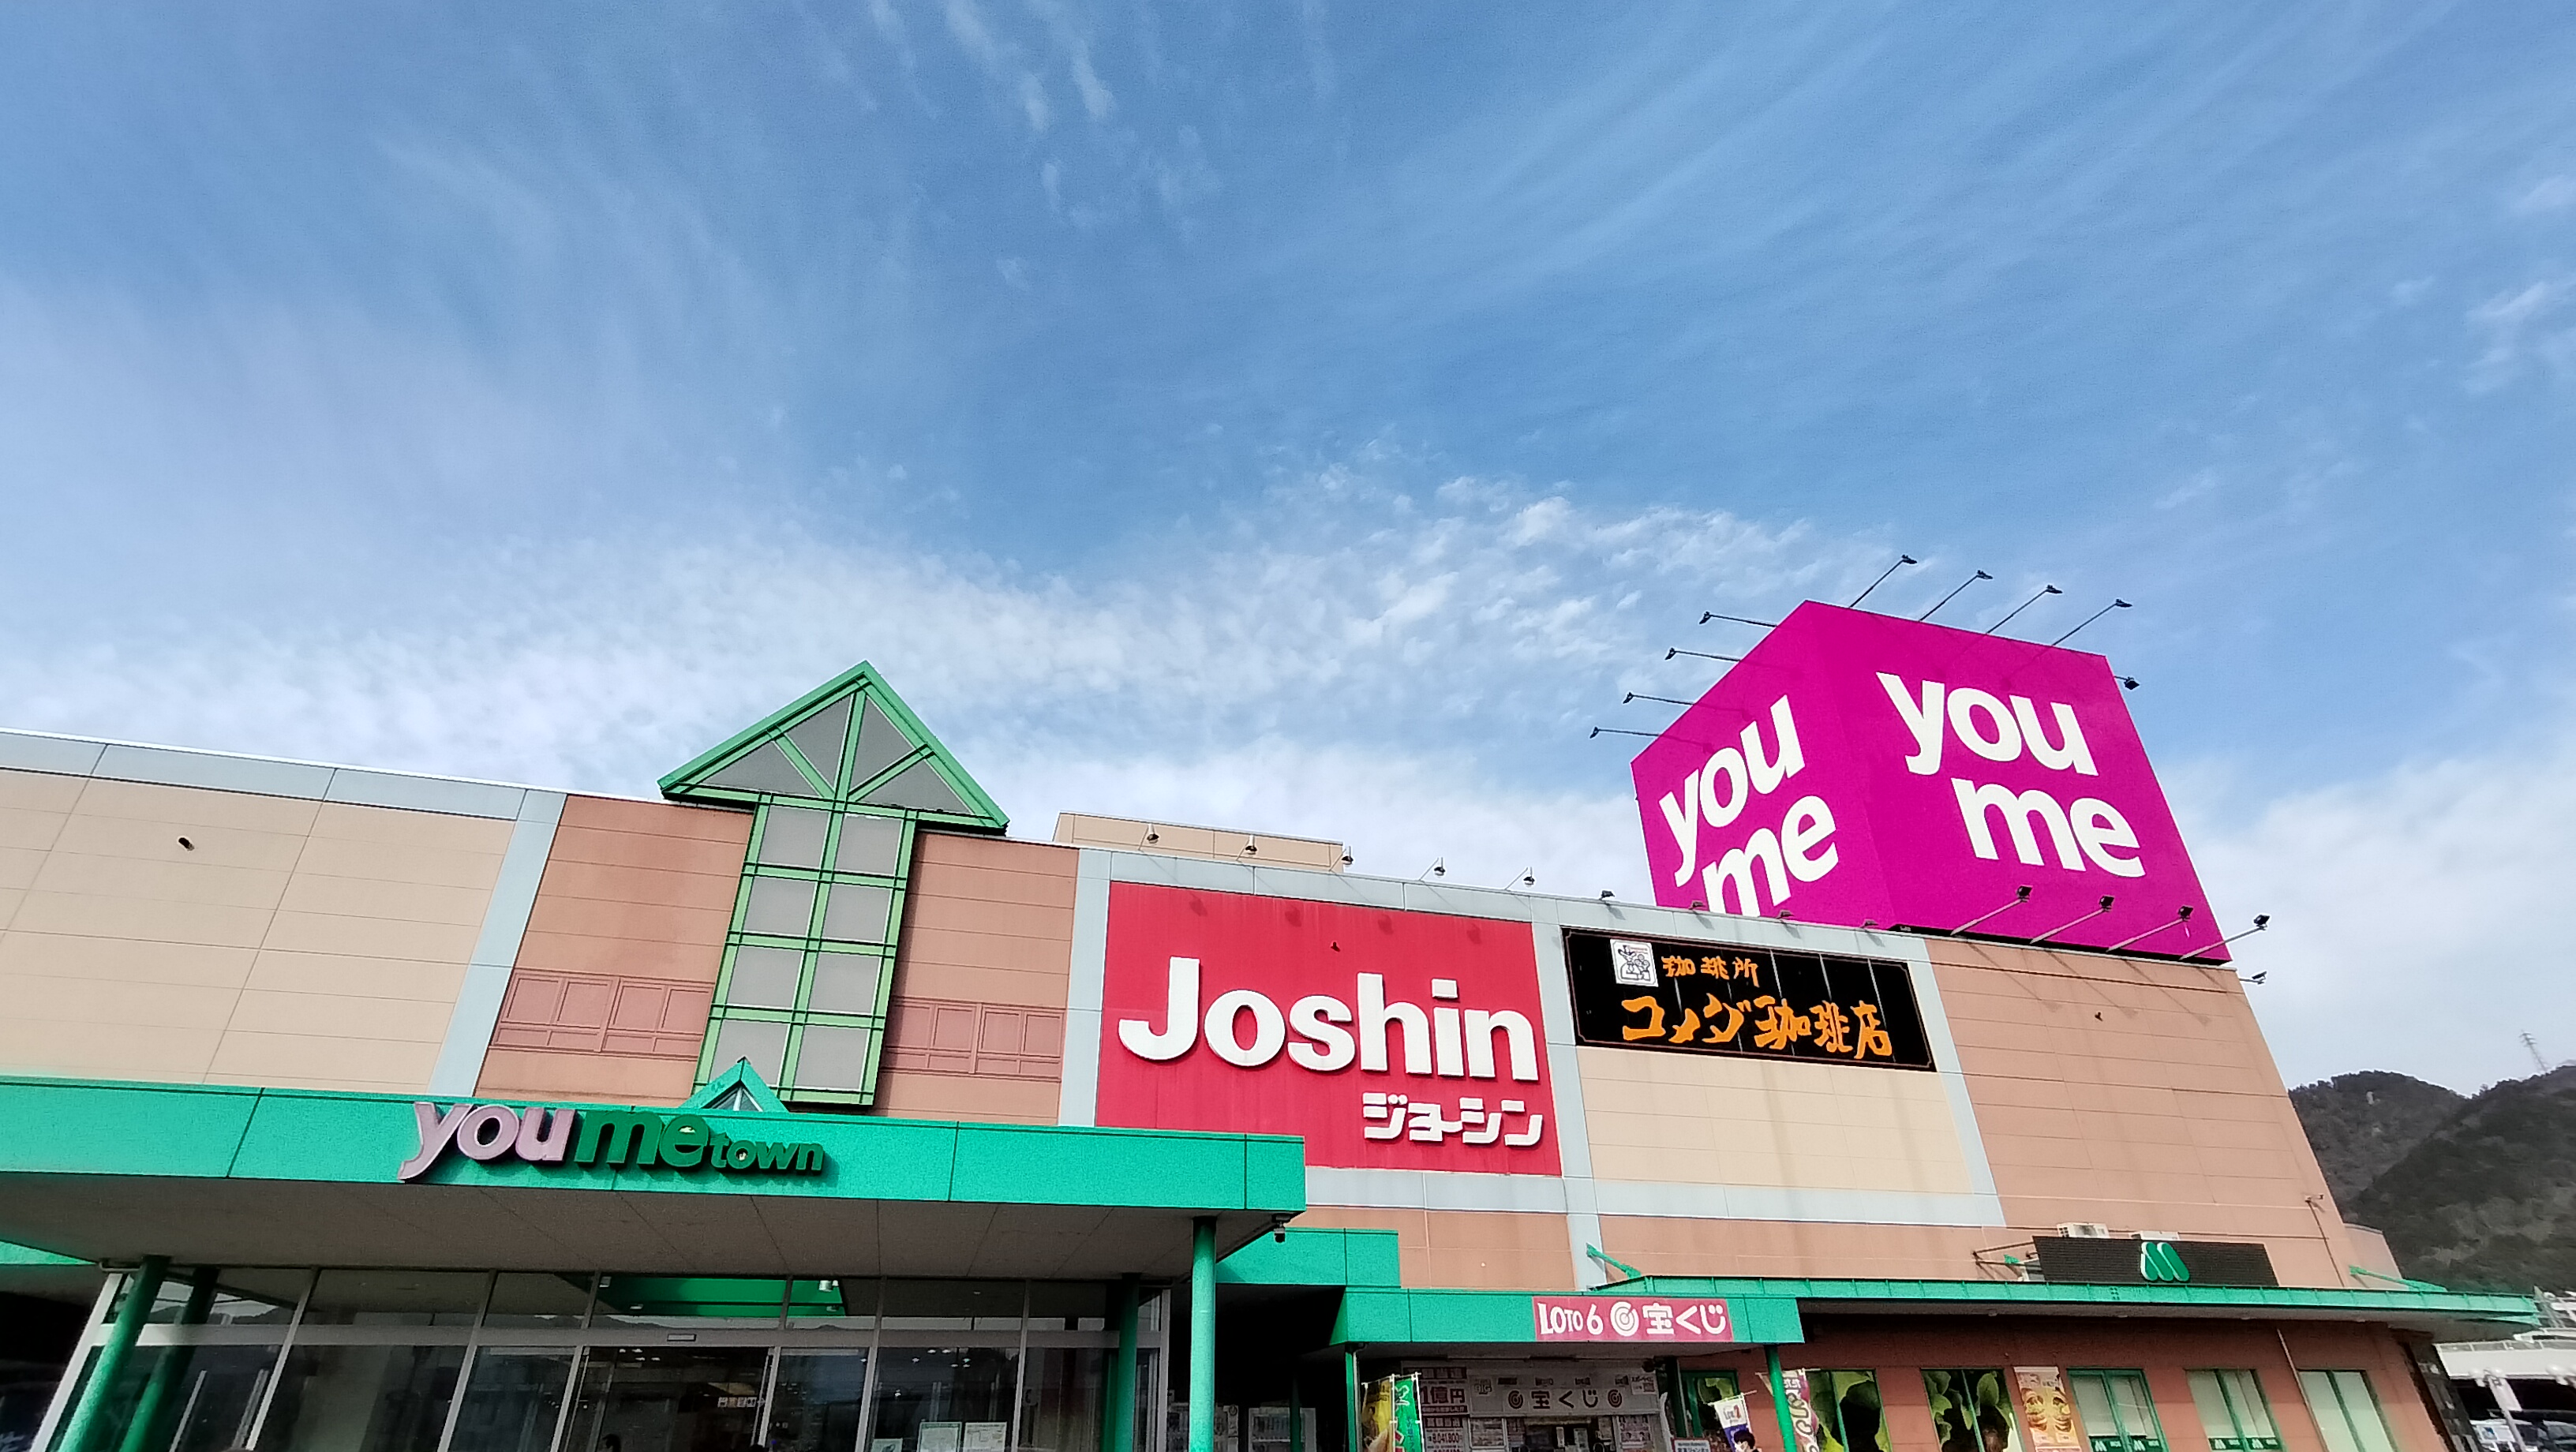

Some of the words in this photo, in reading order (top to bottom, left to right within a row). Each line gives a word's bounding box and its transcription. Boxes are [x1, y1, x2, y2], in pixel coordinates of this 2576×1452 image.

[1876, 672, 2099, 777] you
[1659, 694, 1806, 887] you
[1951, 777, 2146, 878] me
[1702, 795, 1838, 917] me
[1118, 956, 1538, 1081] Joshin
[1621, 992, 1893, 1060] コメダ珈琲店
[1362, 1092, 1543, 1146] ジョーシン
[1537, 1303, 1583, 1334] LOTO
[1586, 1304, 1604, 1335] 6
[1642, 1303, 1726, 1335] 宝くじ
[1531, 1390, 1598, 1409] 宝くじ
